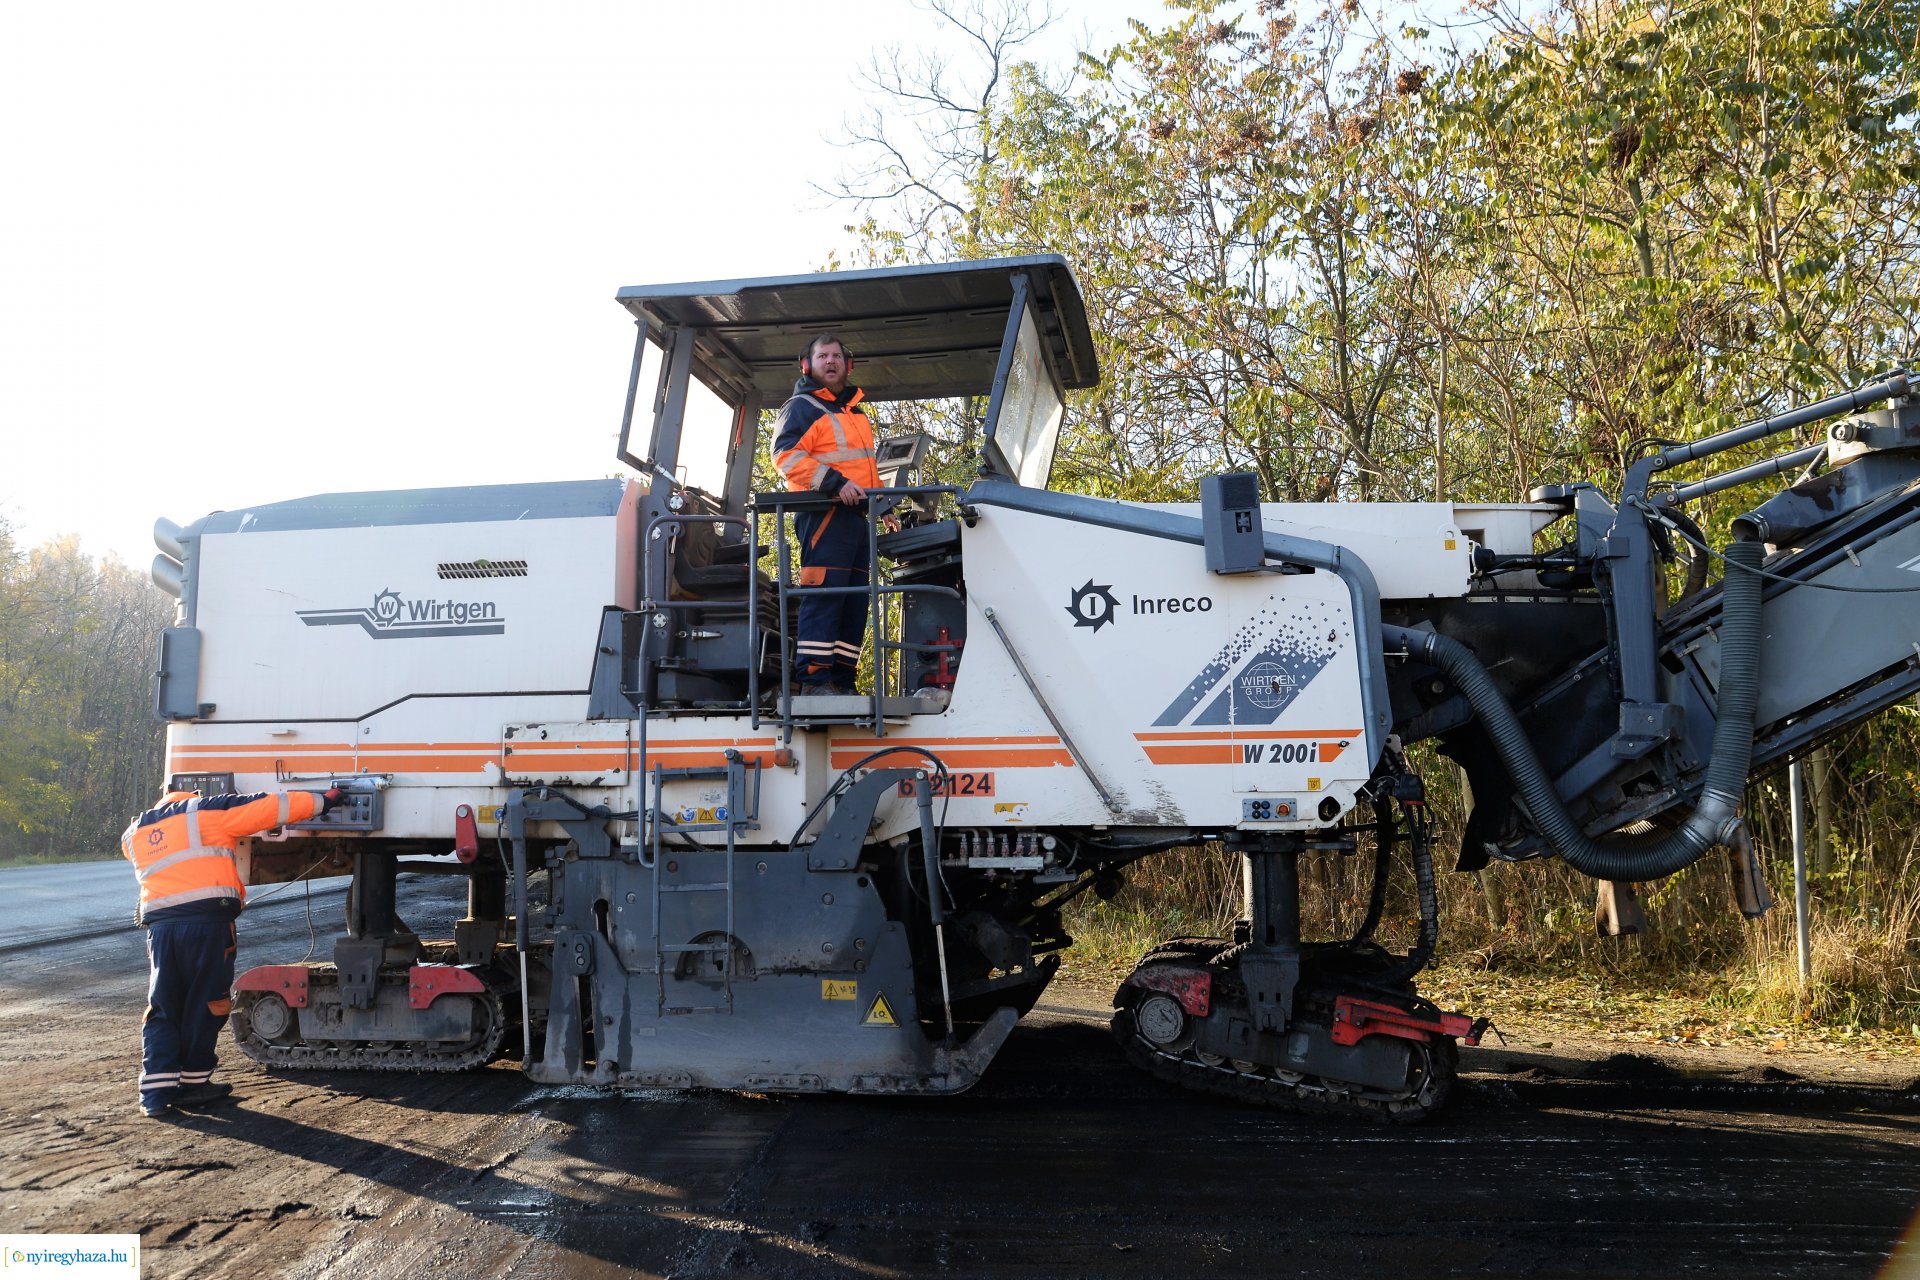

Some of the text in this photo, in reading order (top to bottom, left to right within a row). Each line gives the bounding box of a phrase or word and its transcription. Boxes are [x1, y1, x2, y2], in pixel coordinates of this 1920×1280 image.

[380, 601, 395, 615] W
[407, 599, 496, 625] Wirtgen
[1133, 594, 1213, 615] Inreco
[1240, 674, 1296, 687] WIRTGEN
[1244, 742, 1317, 763] W 200i
[900, 773, 991, 796] 62124
